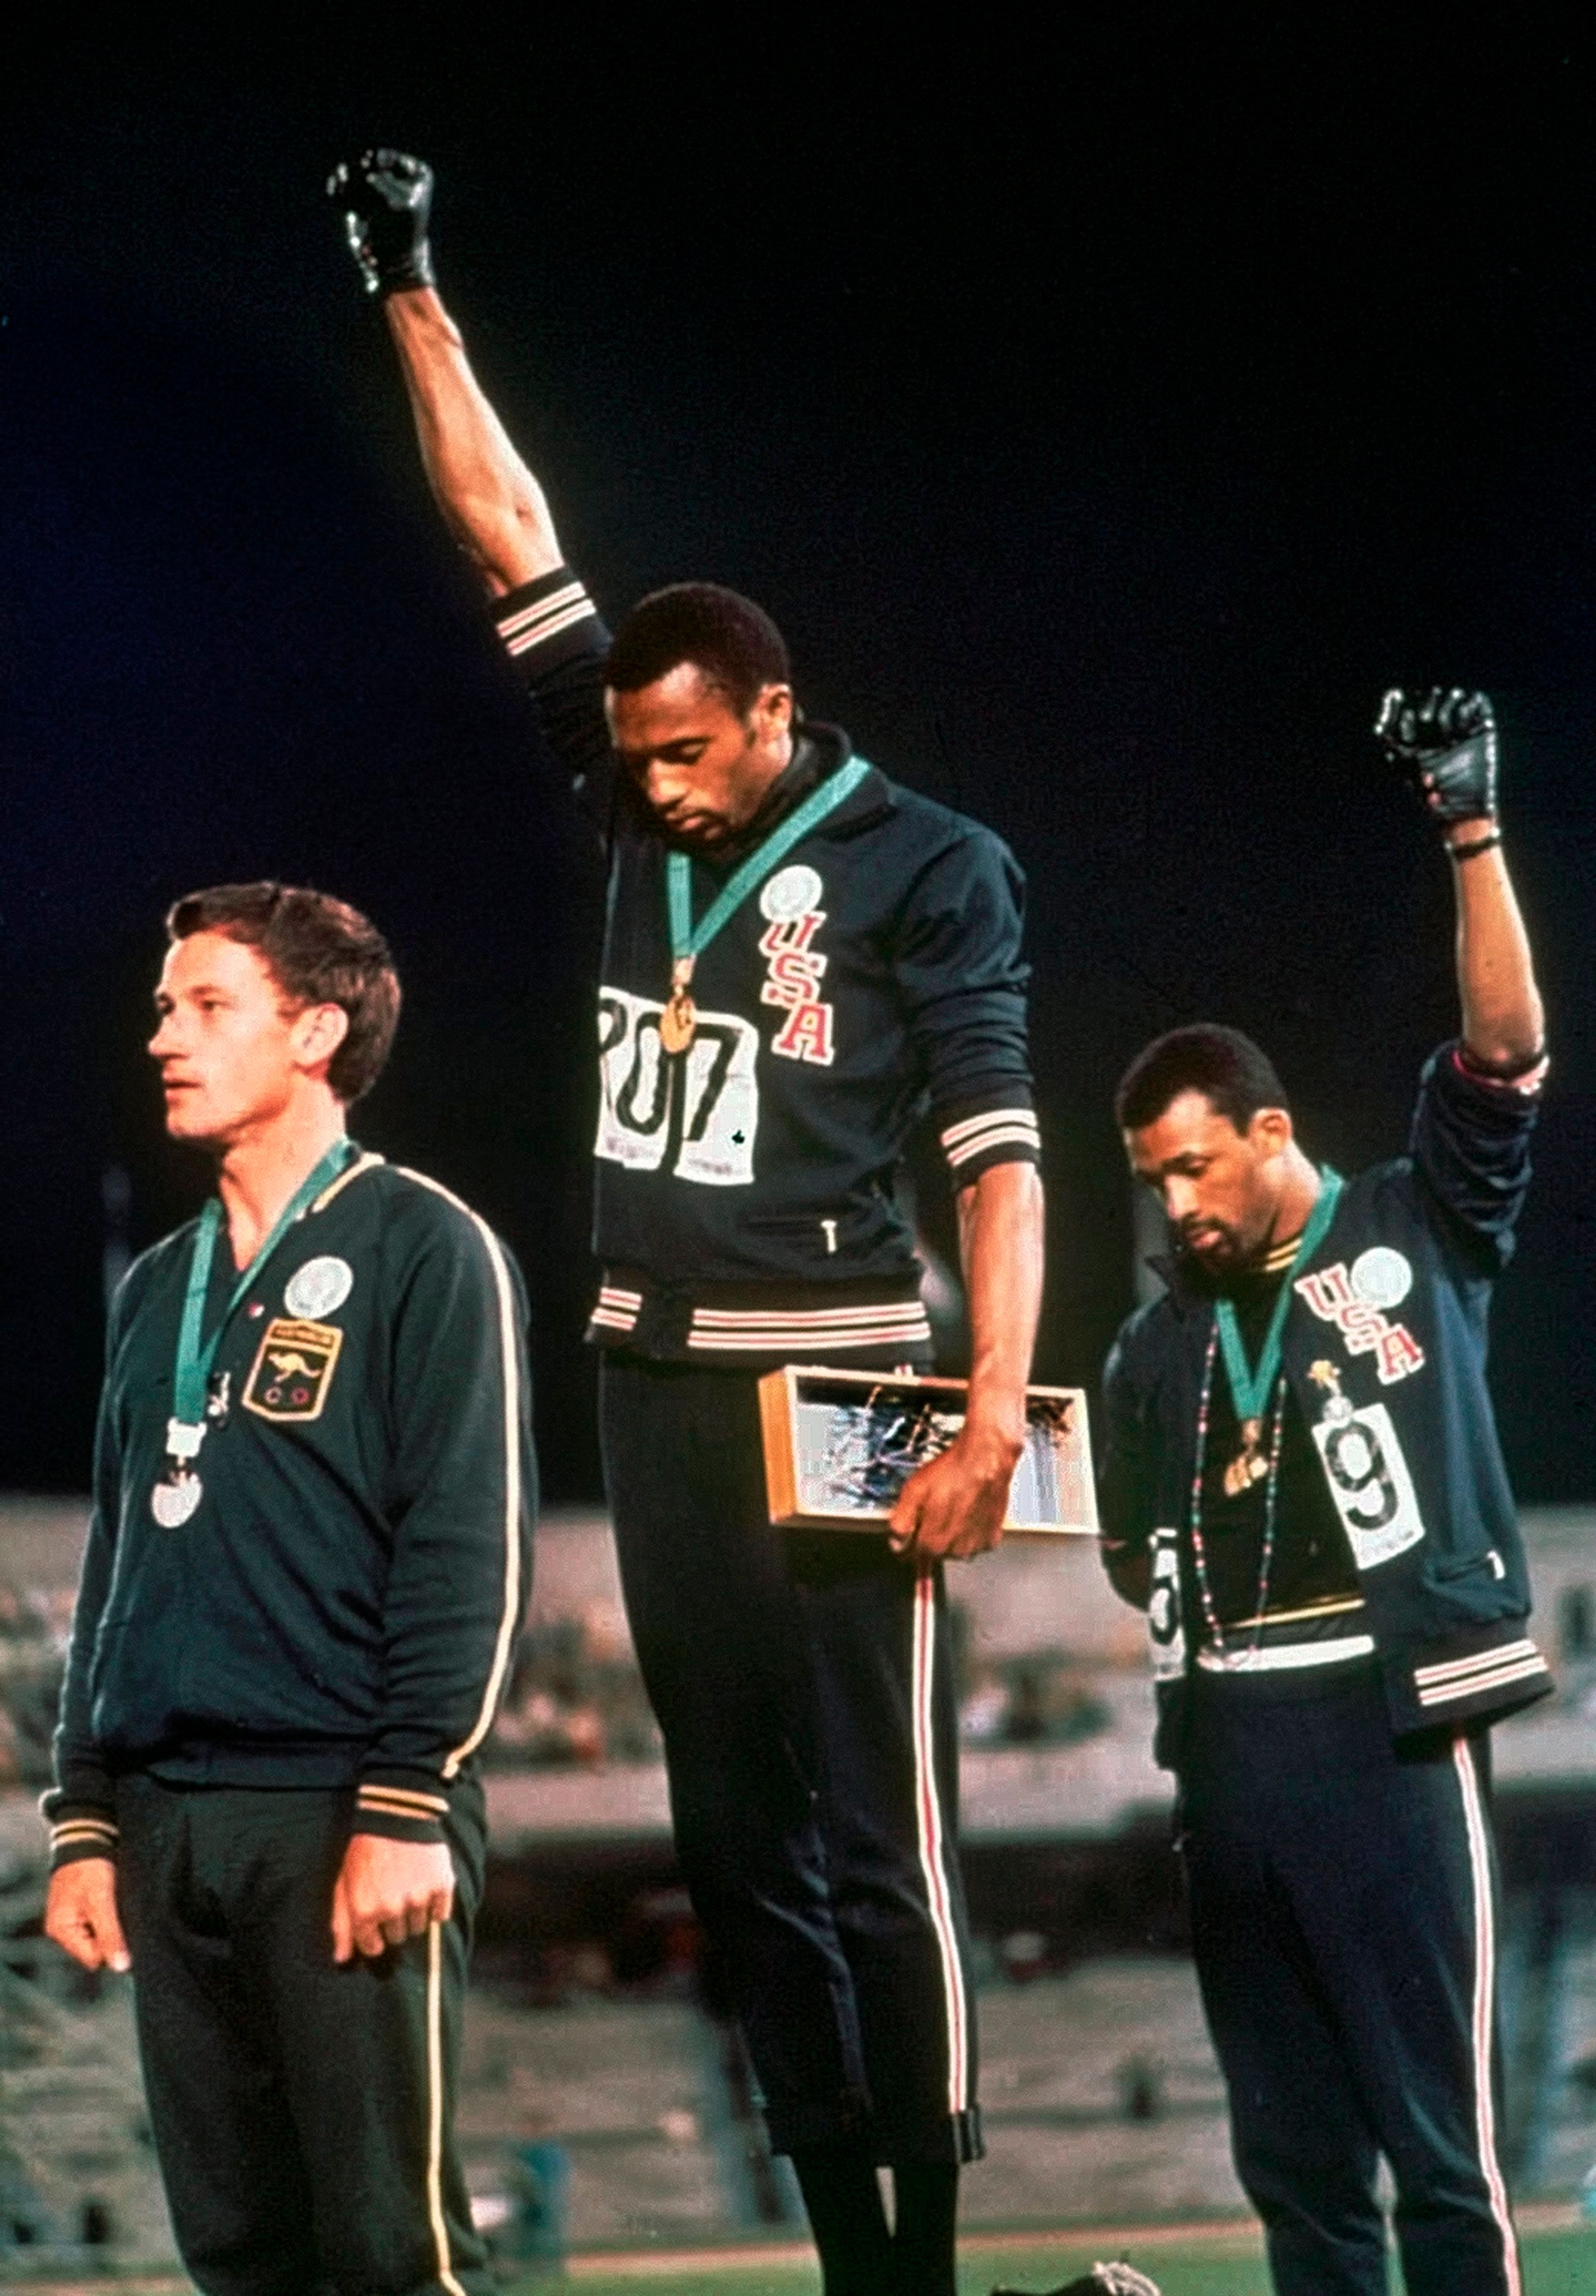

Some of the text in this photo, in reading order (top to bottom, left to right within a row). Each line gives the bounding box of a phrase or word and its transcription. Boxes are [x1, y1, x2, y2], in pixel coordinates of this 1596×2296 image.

[760, 912, 834, 1065] USA
[1294, 1263, 1425, 1385] USA
[1325, 1421, 1399, 1531] 9
